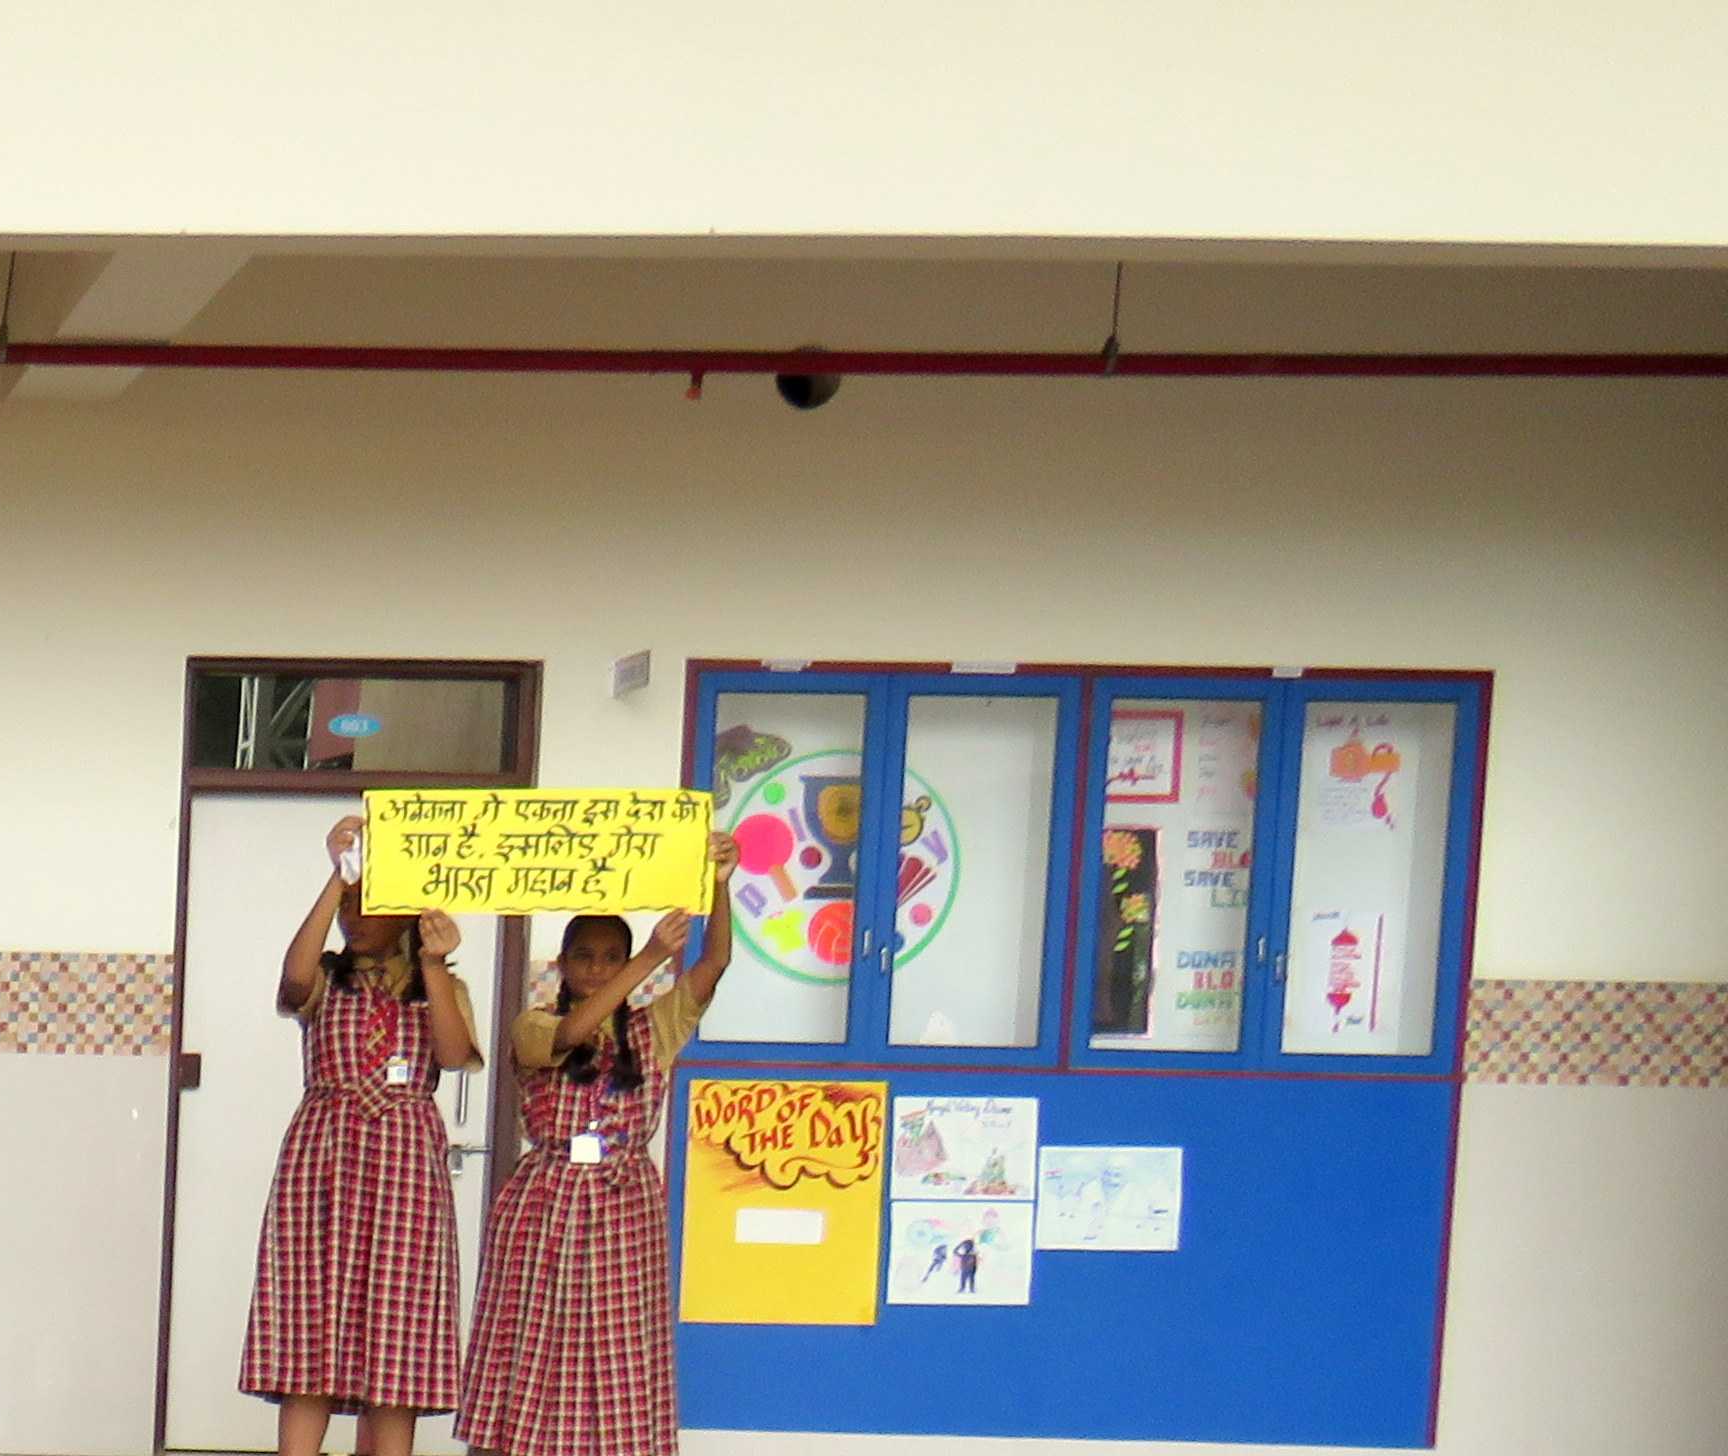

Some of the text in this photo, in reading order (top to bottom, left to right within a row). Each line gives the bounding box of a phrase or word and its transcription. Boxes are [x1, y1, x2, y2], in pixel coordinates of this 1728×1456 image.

[582, 799, 620, 826] इस
[604, 825, 664, 861] मेरा
[421, 862, 499, 904] भारत
[507, 866, 578, 897] महान
[695, 1088, 818, 1132] WORD OF
[741, 1124, 794, 1156] THE
